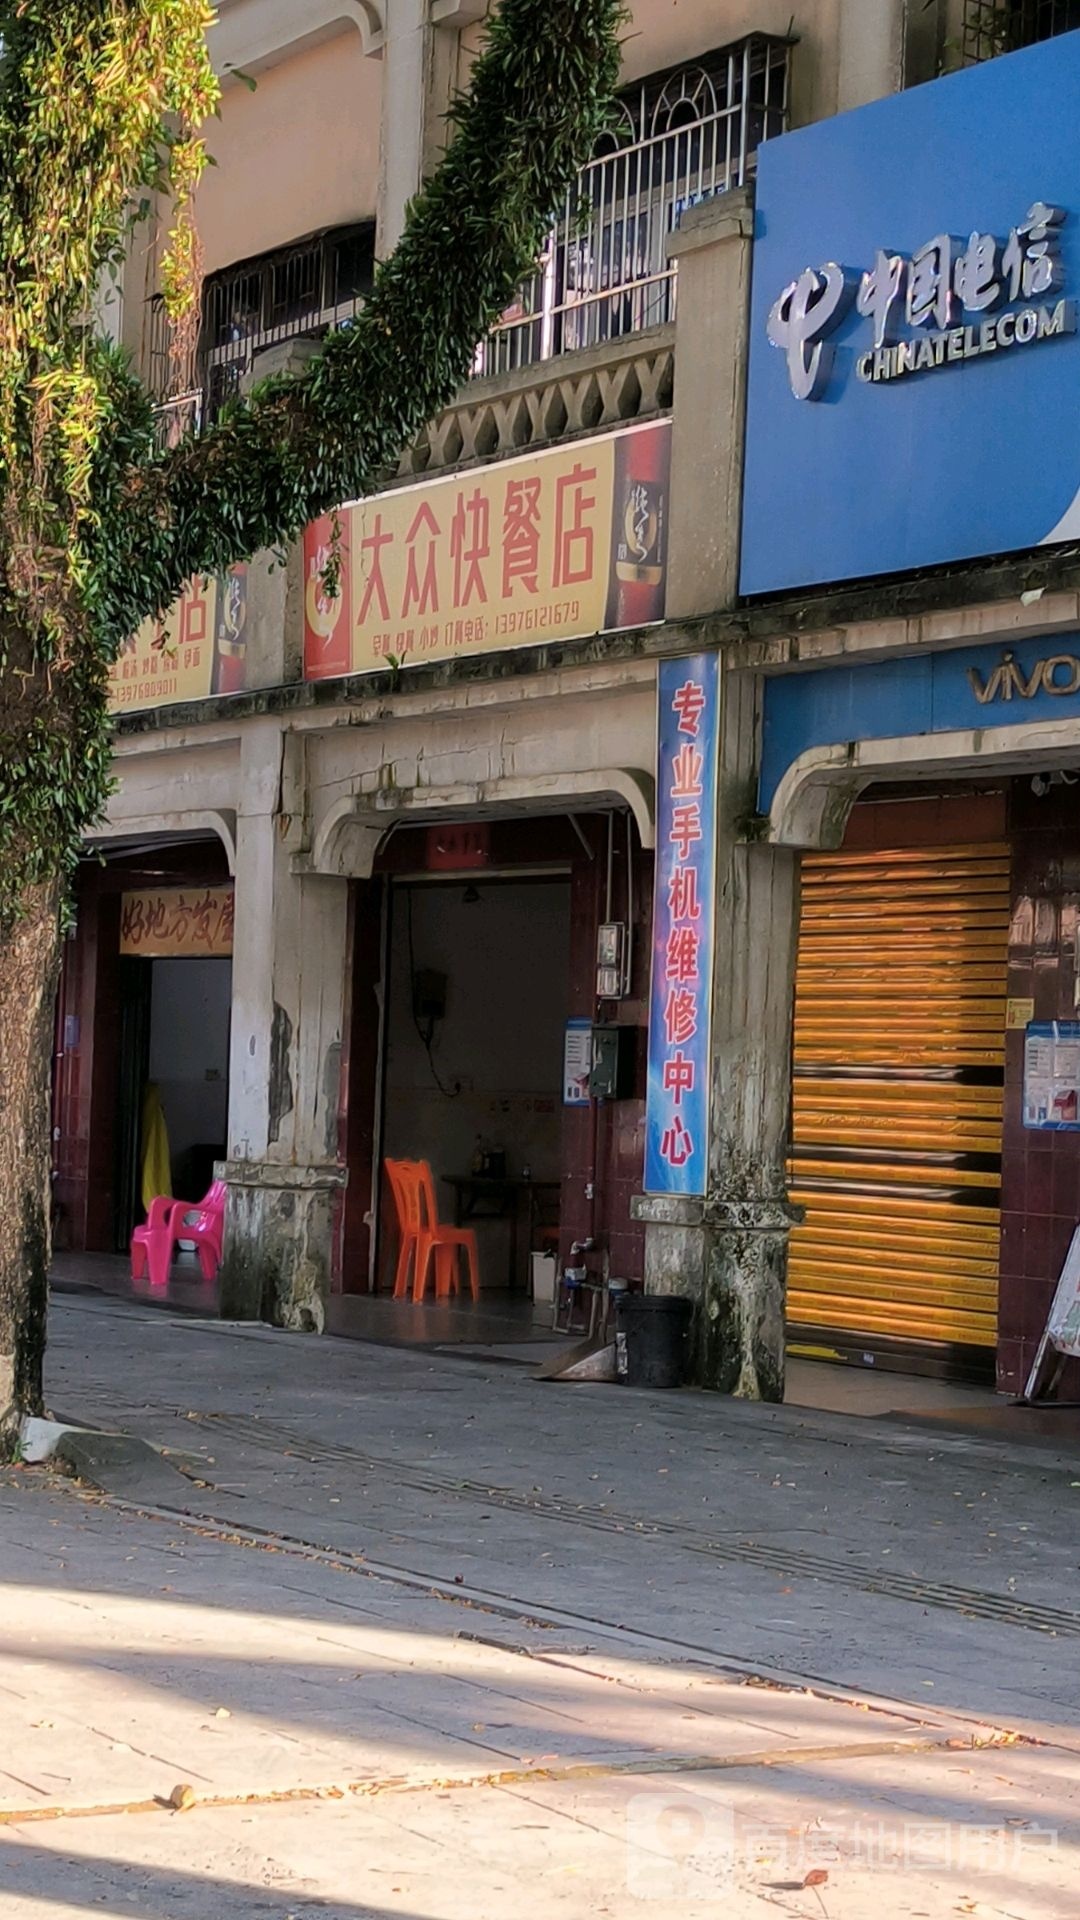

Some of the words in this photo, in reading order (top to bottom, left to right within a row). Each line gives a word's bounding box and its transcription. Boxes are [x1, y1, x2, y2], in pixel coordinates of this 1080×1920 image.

[856, 201, 1060, 349] 中国电信
[356, 462, 597, 626] 大众快餐店
[966, 650, 1080, 704] vivo
[659, 679, 706, 1169] 专业手机维修中心
